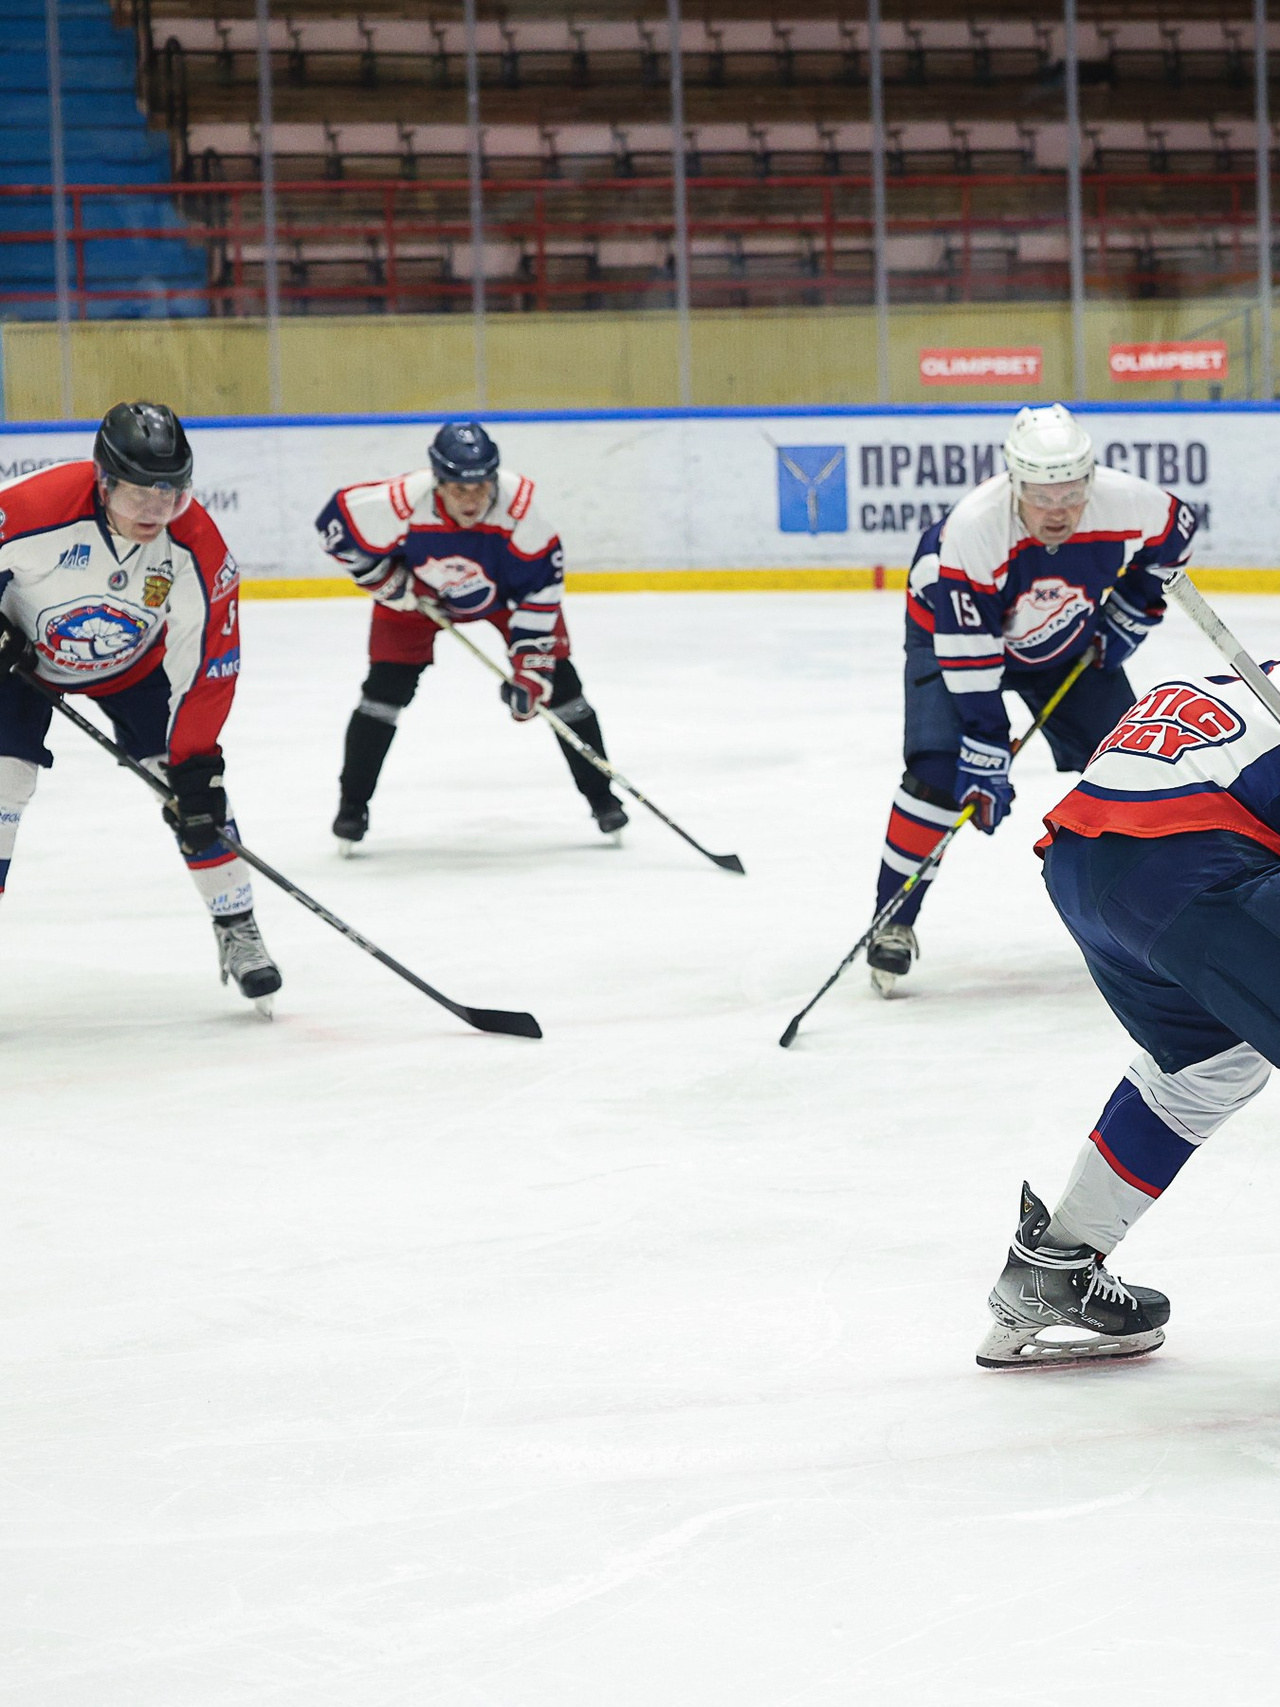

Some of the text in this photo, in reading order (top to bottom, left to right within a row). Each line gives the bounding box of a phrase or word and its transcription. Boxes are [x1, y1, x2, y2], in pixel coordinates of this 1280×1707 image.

[920, 355, 1039, 377] OLIMPBET
[1110, 351, 1222, 373] OLIMPBET
[860, 442, 1209, 487] ПРАВИСТВО
